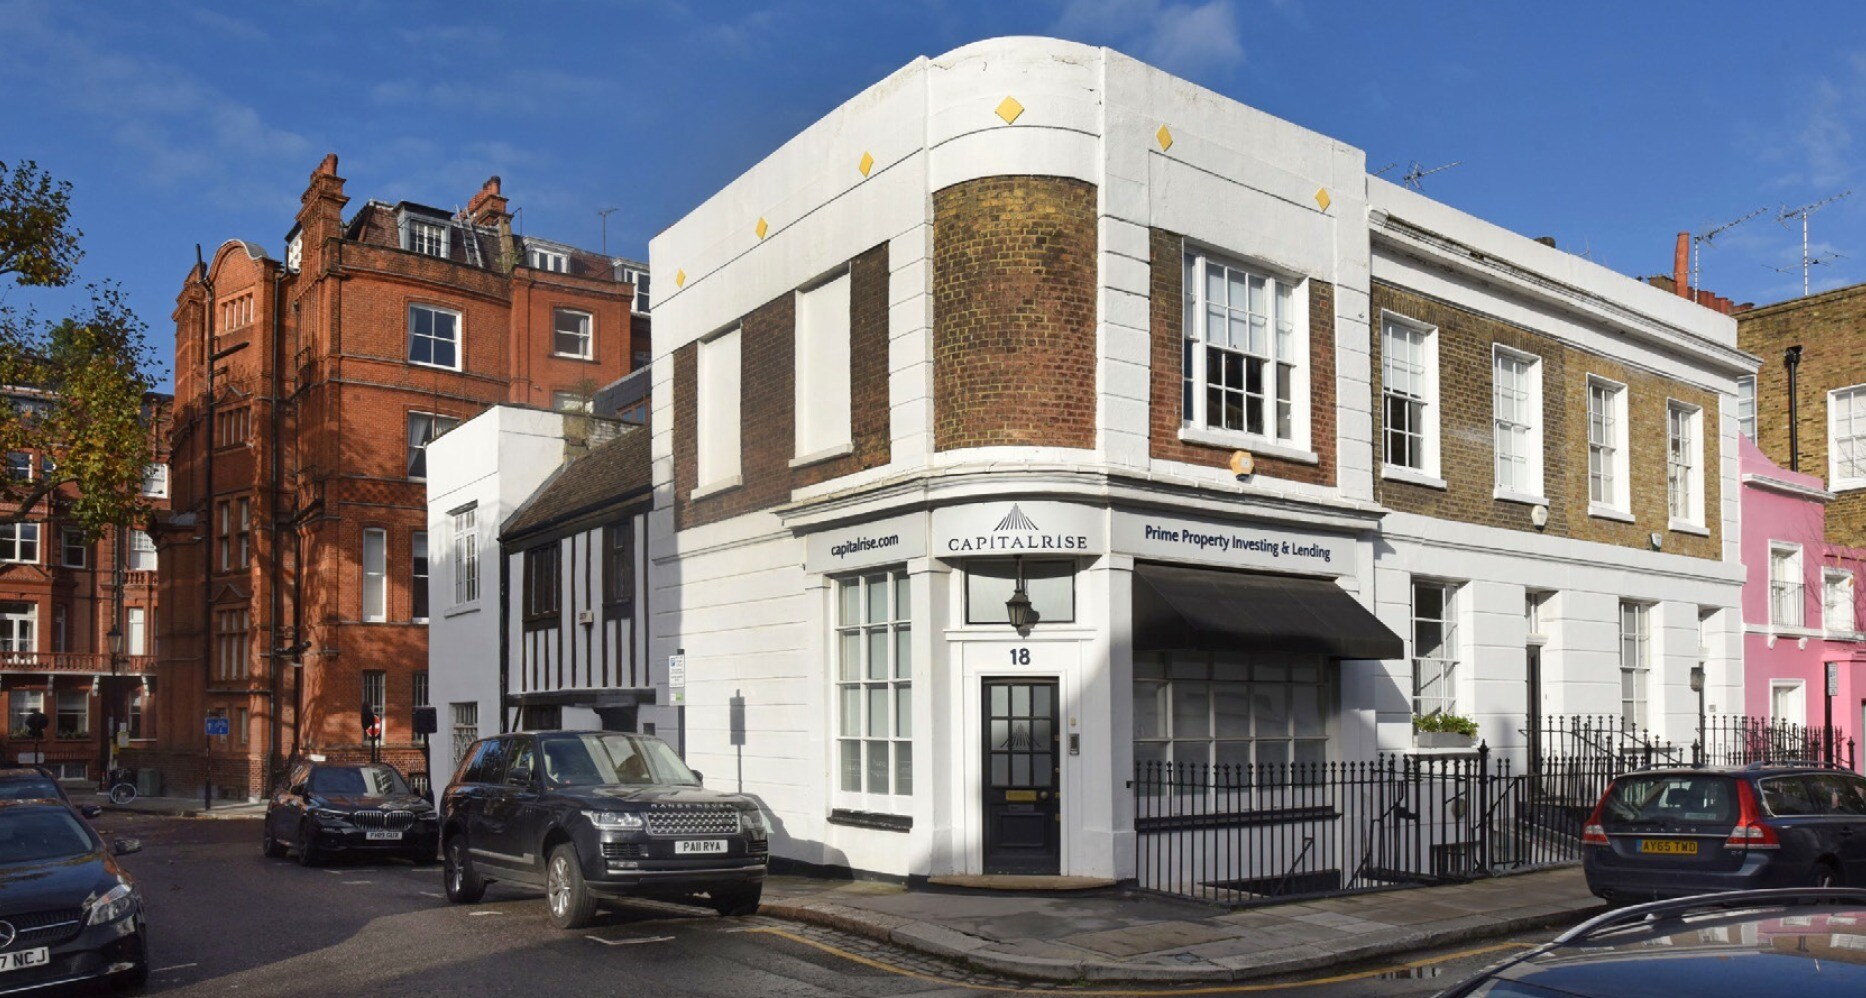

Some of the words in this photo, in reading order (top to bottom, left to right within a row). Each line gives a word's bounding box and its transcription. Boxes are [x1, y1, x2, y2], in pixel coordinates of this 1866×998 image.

[831, 533, 899, 559] capitalrise.com
[948, 535, 1088, 551] CAPITALRISE
[1145, 525, 1179, 541] Prime
[1182, 529, 1230, 551] Property
[1232, 535, 1279, 557] Investing
[1281, 541, 1290, 555] &
[1292, 542, 1331, 562] Lending
[1010, 648, 1031, 665] 18
[703, 842, 721, 852] RYA
[1643, 841, 1671, 852] AY65
[1672, 841, 1696, 852] TWD
[13, 949, 46, 967] NCJ
